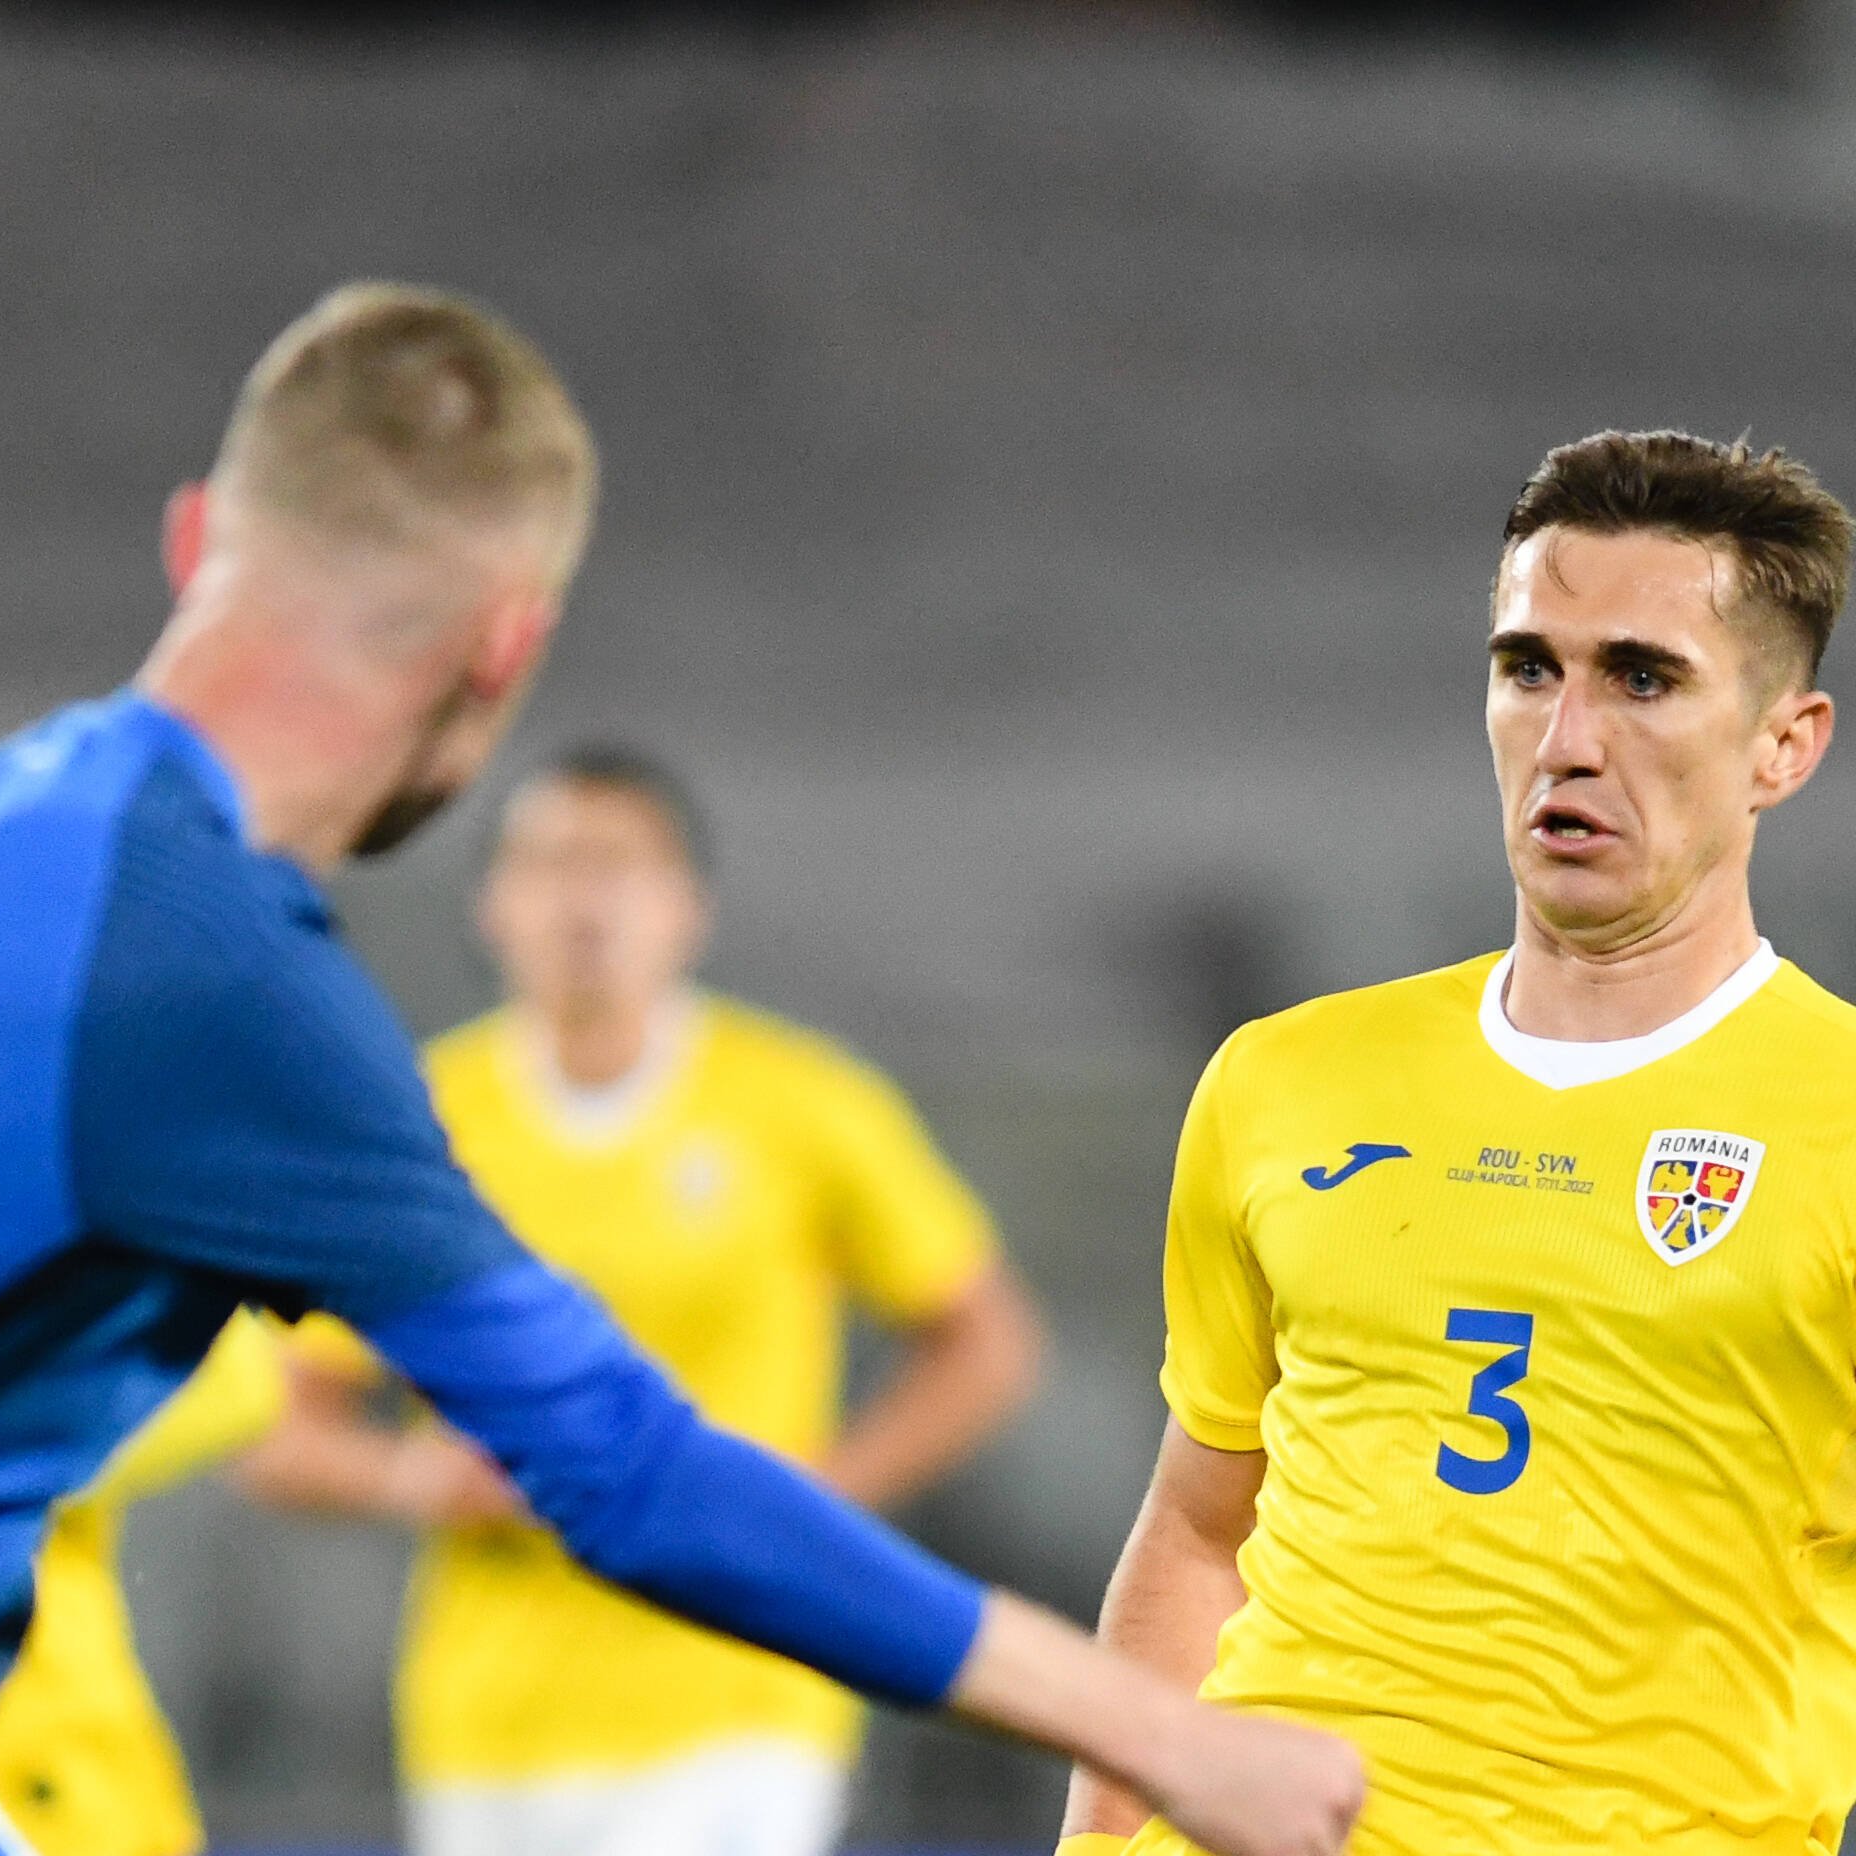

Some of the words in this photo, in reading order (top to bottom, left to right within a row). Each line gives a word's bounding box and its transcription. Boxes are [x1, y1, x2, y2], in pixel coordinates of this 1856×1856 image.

[1477, 1147, 1520, 1169] ROU
[1535, 1152, 1576, 1175] SVN
[1436, 1308, 1534, 1495] 3
